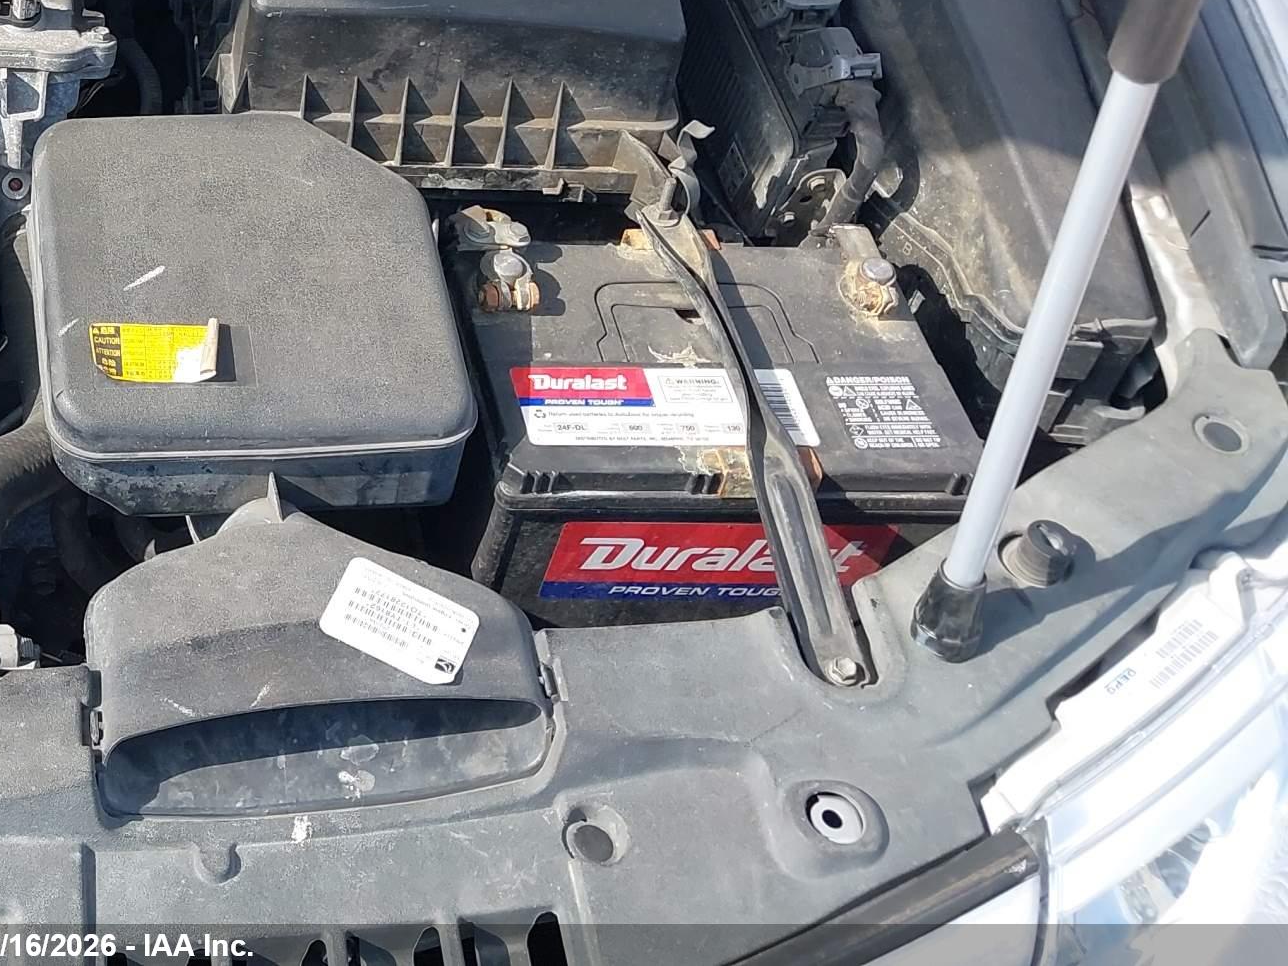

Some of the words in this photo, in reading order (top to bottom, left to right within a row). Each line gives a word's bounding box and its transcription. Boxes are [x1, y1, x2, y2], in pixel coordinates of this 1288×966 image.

[94, 336, 121, 345] CAUTION
[527, 373, 628, 392] Duralast
[833, 376, 911, 384] DANGER/POISON
[544, 398, 586, 407] PROVEN
[579, 537, 864, 572] Duralat
[608, 585, 710, 597] PROVEN
[717, 585, 783, 597] TOUG
